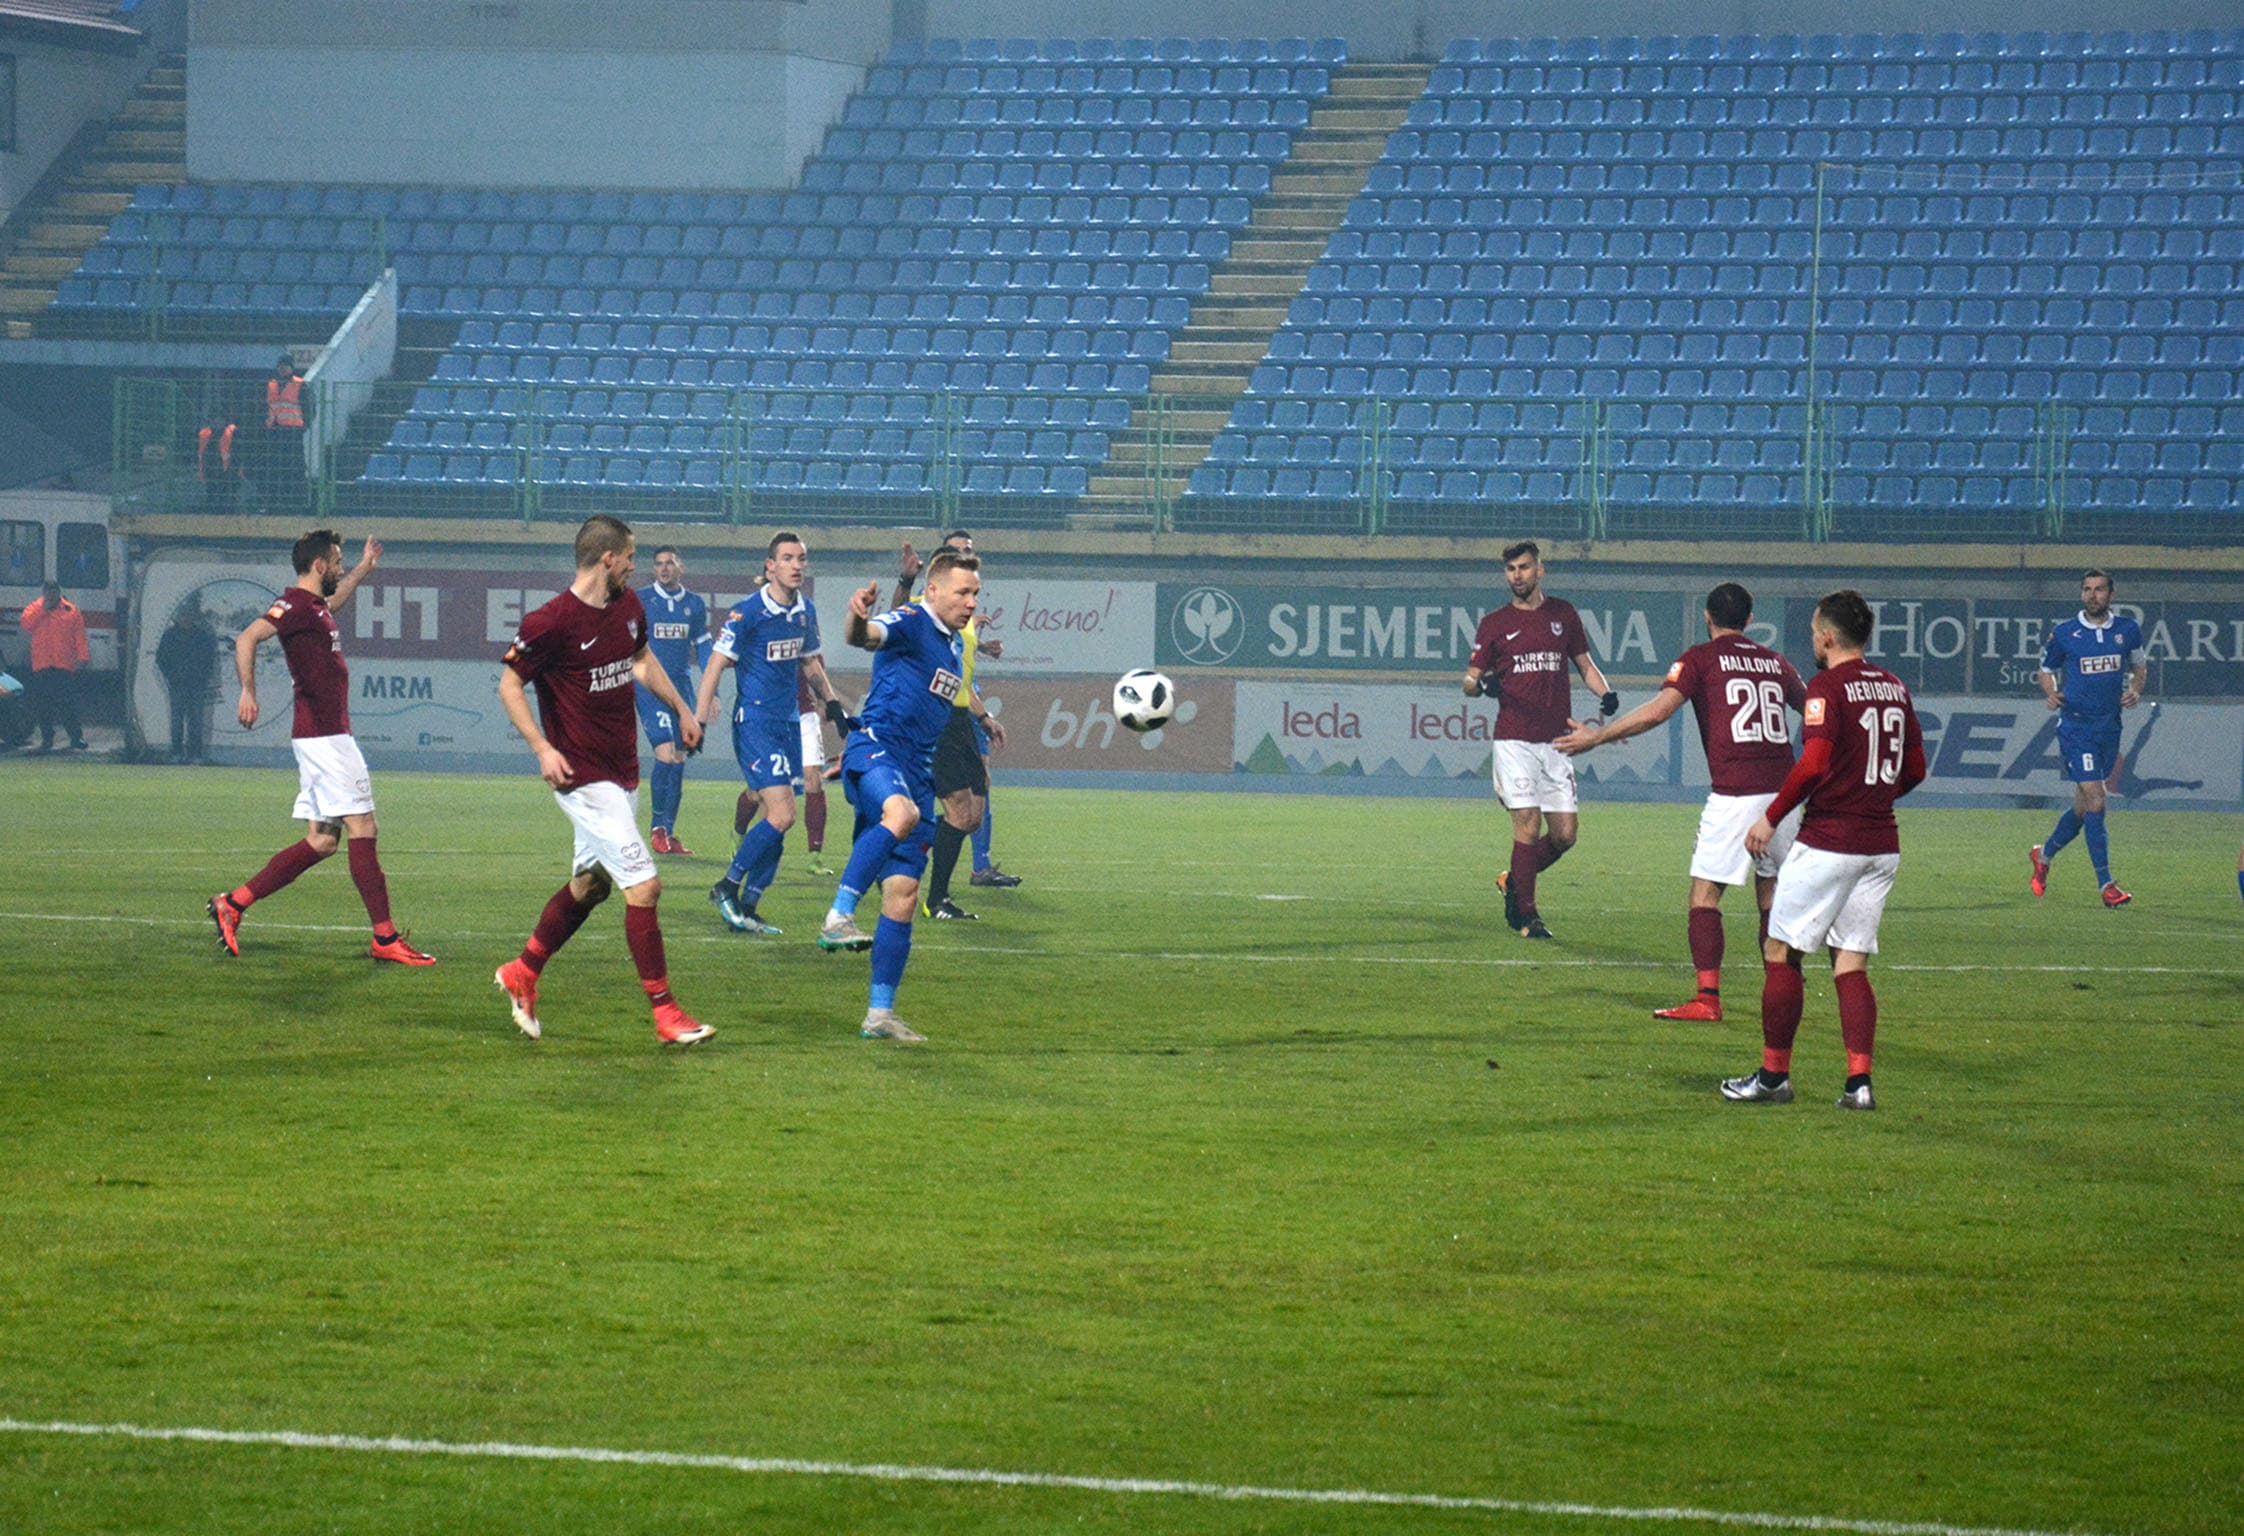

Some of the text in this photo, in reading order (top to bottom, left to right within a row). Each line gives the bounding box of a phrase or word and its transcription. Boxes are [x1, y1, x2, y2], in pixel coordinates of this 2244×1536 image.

[1018, 588, 1116, 632] kasno!
[1267, 603, 1658, 664] SJEMENNA
[1863, 601, 2066, 659] HOTE
[588, 656, 634, 680] TURKIS
[1512, 651, 1562, 664] TURKISH
[2082, 656, 2119, 672] FEAL
[362, 675, 433, 699] MRM
[589, 670, 634, 692] AIRLIN
[932, 671, 962, 699] FEA
[1041, 698, 1116, 749] bh
[1282, 701, 1362, 739] leda
[1410, 702, 1491, 741] leda
[1725, 677, 1789, 743] 26
[1859, 706, 1906, 785] 13
[2082, 752, 2094, 771] 6
